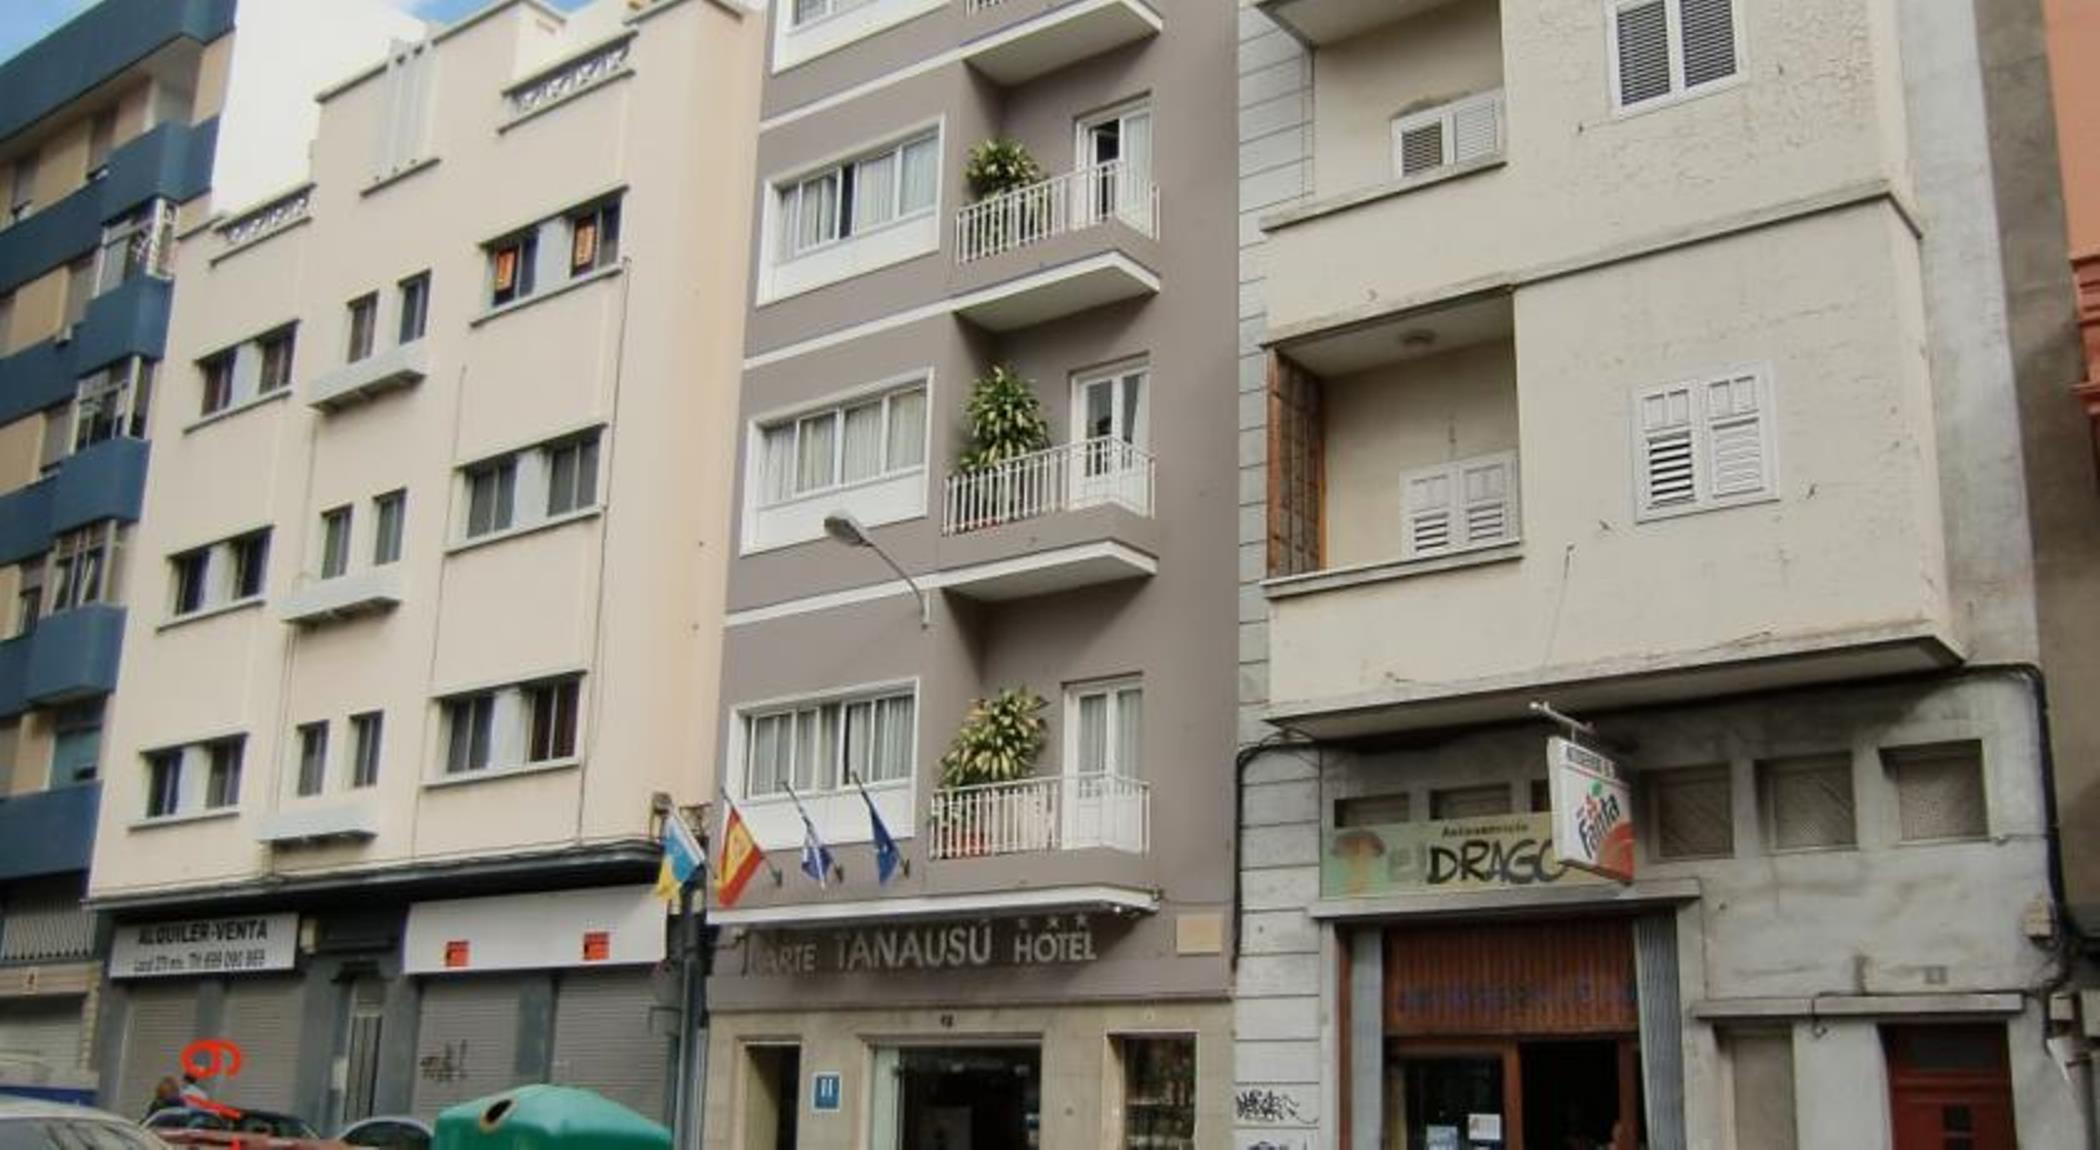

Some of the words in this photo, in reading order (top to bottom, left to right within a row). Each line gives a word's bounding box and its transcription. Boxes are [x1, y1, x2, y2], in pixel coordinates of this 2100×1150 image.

[138, 919, 268, 945] ALQUILER-VENTA
[834, 919, 992, 970] TANAUSÚ
[1013, 931, 1097, 964] HOTEL
